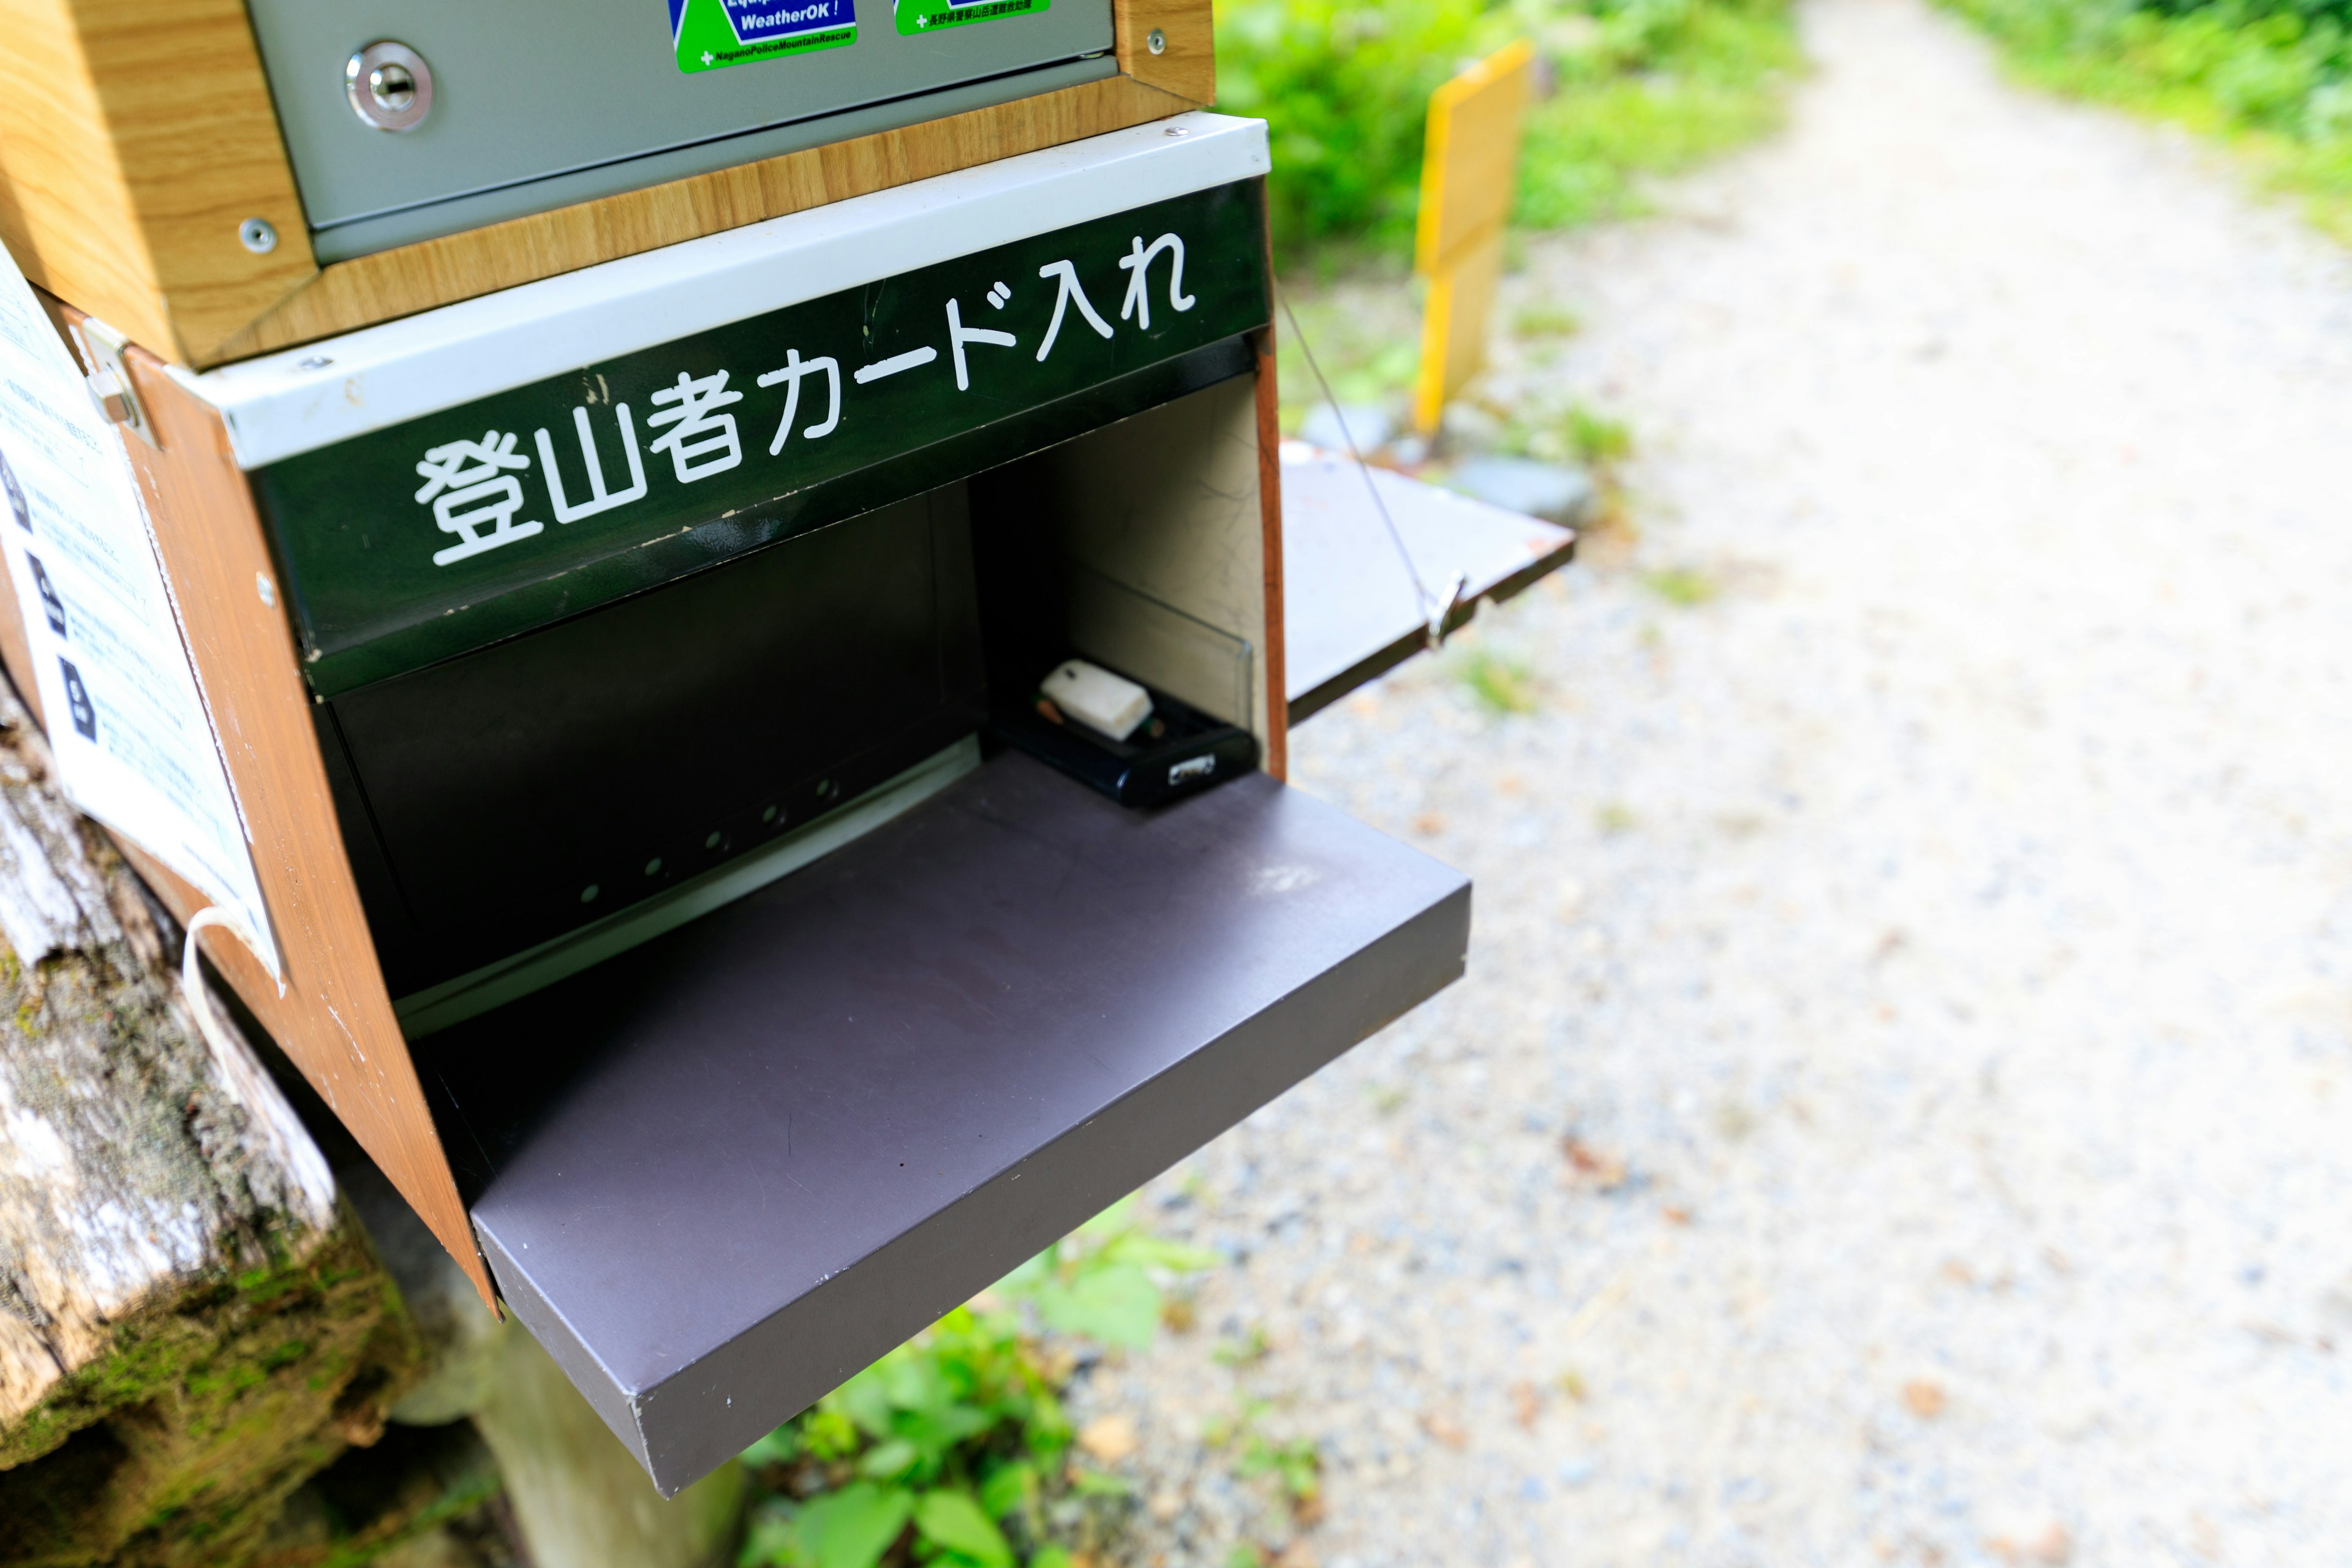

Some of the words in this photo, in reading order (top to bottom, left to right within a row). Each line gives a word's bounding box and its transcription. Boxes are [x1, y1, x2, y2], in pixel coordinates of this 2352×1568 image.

[715, 31, 851, 61] NaganoPoliceMountainRescue
[415, 232, 1195, 566] 登山者カード入れ
